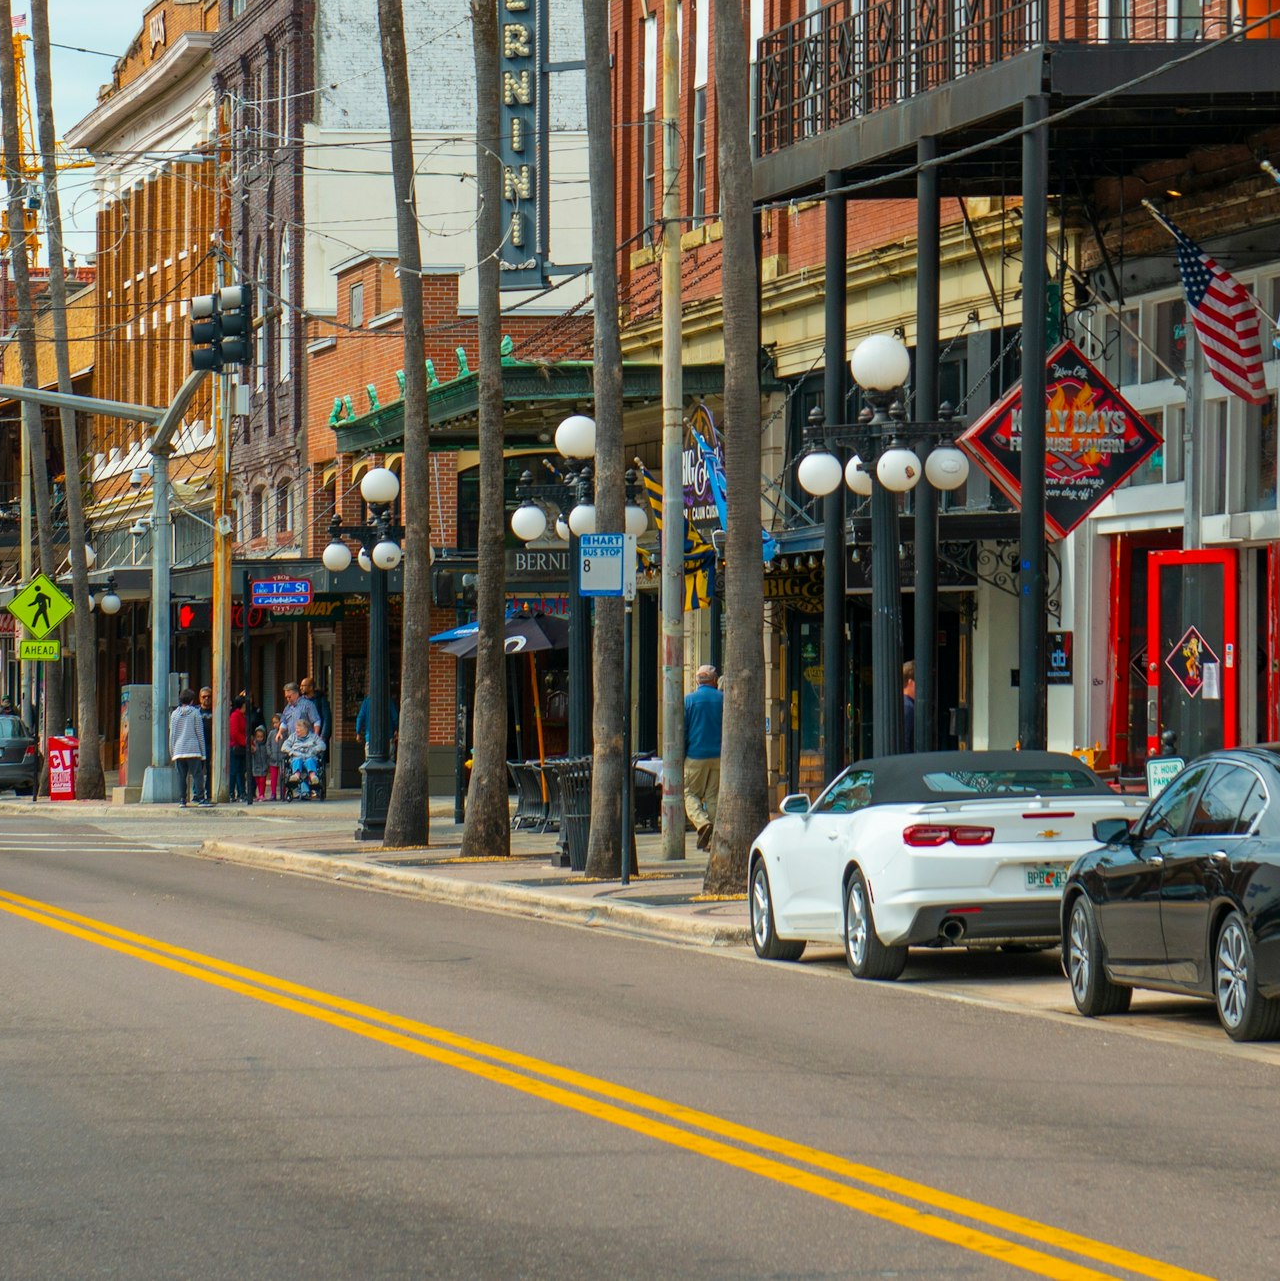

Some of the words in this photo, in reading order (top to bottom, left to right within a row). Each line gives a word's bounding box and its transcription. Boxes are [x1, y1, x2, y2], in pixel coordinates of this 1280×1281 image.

[1011, 409, 1068, 433] KLY
[1073, 410, 1126, 434] DAYS
[1078, 438, 1125, 453] TAVERN
[592, 536, 620, 545] HART
[583, 548, 597, 556] BUS
[600, 548, 621, 556] STOP
[583, 559, 591, 572] 8
[273, 582, 291, 594] 17th
[295, 582, 306, 593] St
[272, 604, 290, 612] CITY
[24, 645, 55, 655] AHEAD
[1154, 766, 1158, 775] 2
[1161, 764, 1178, 774] HOUR
